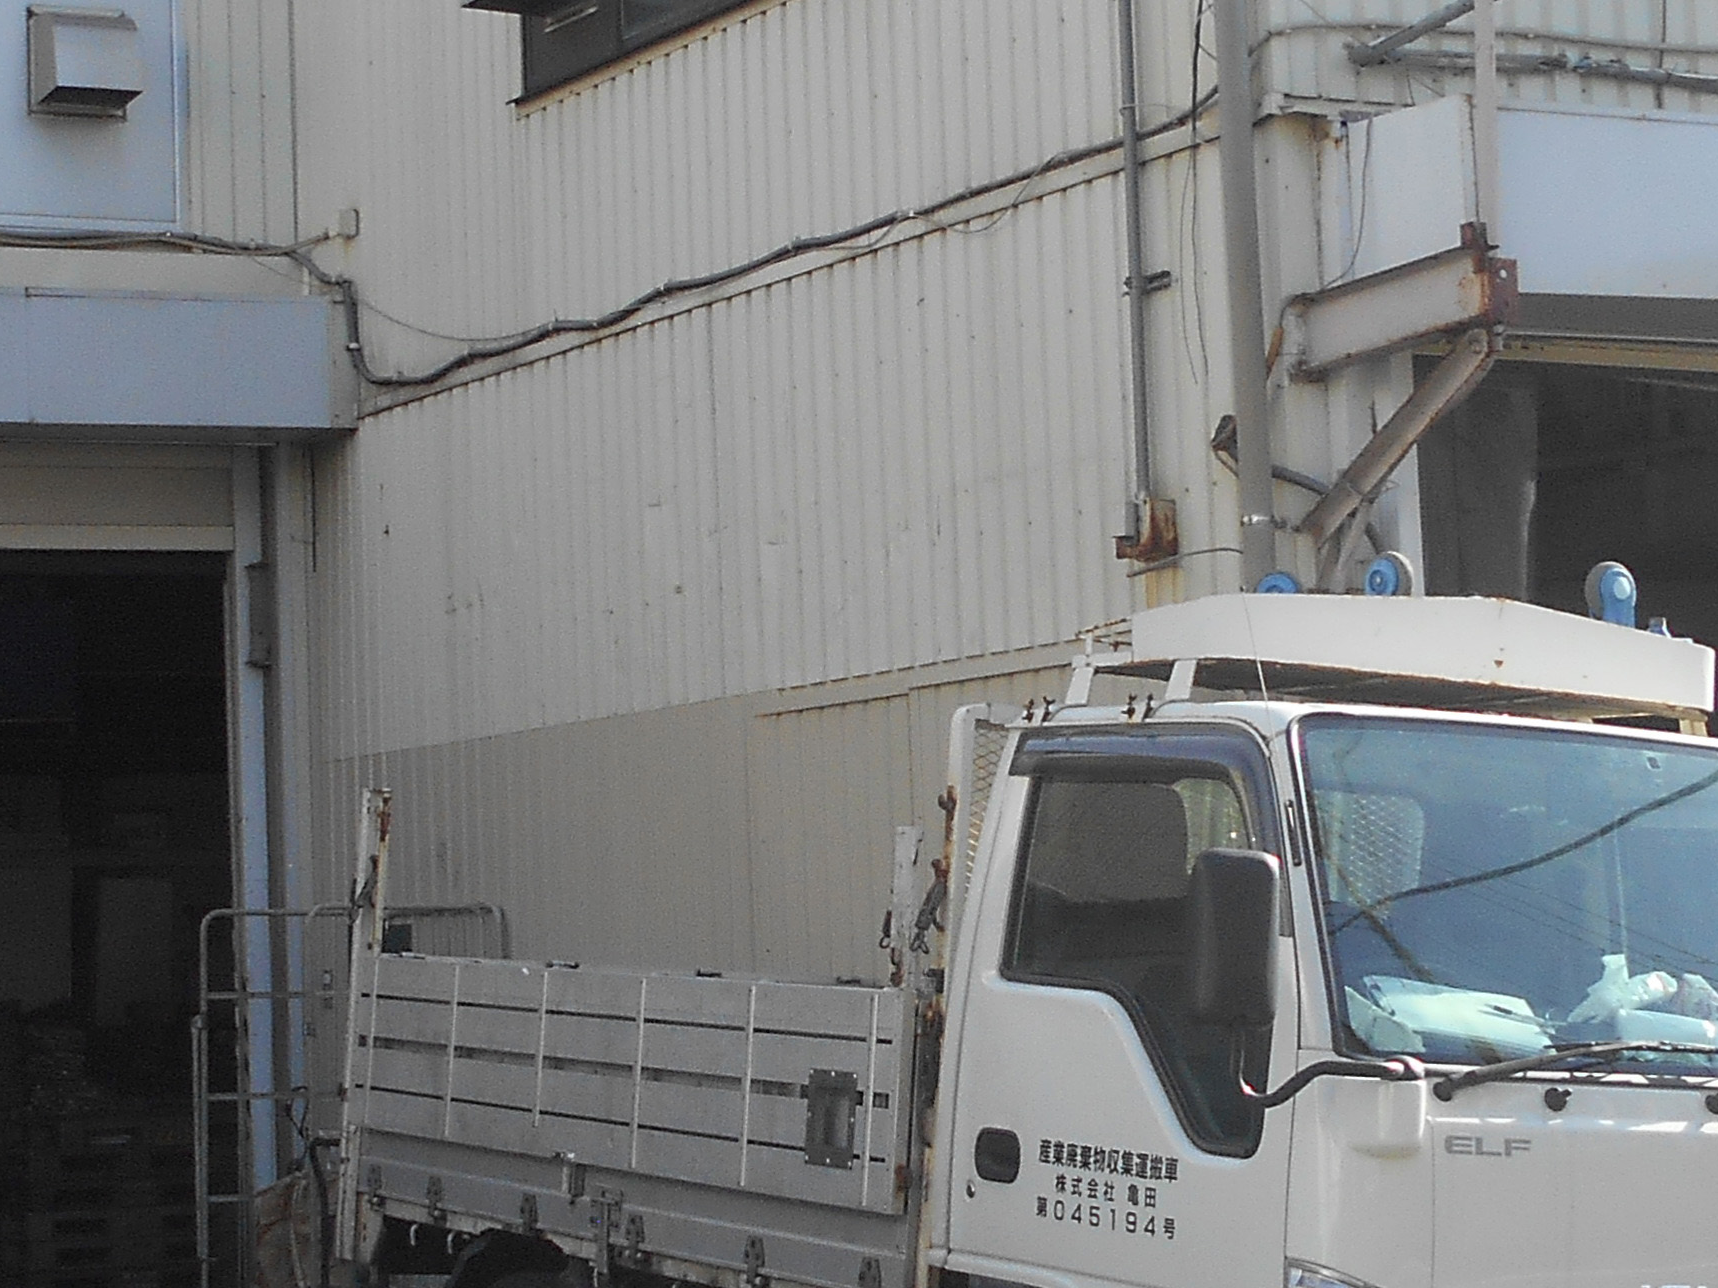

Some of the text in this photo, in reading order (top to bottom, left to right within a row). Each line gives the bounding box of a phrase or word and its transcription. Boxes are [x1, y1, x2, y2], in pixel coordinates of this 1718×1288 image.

[1038, 1138, 1179, 1184] 産業廃棄物収集運搬車
[1444, 1134, 1532, 1157] ELF
[1055, 1172, 1157, 1209] 株式会社 亀田
